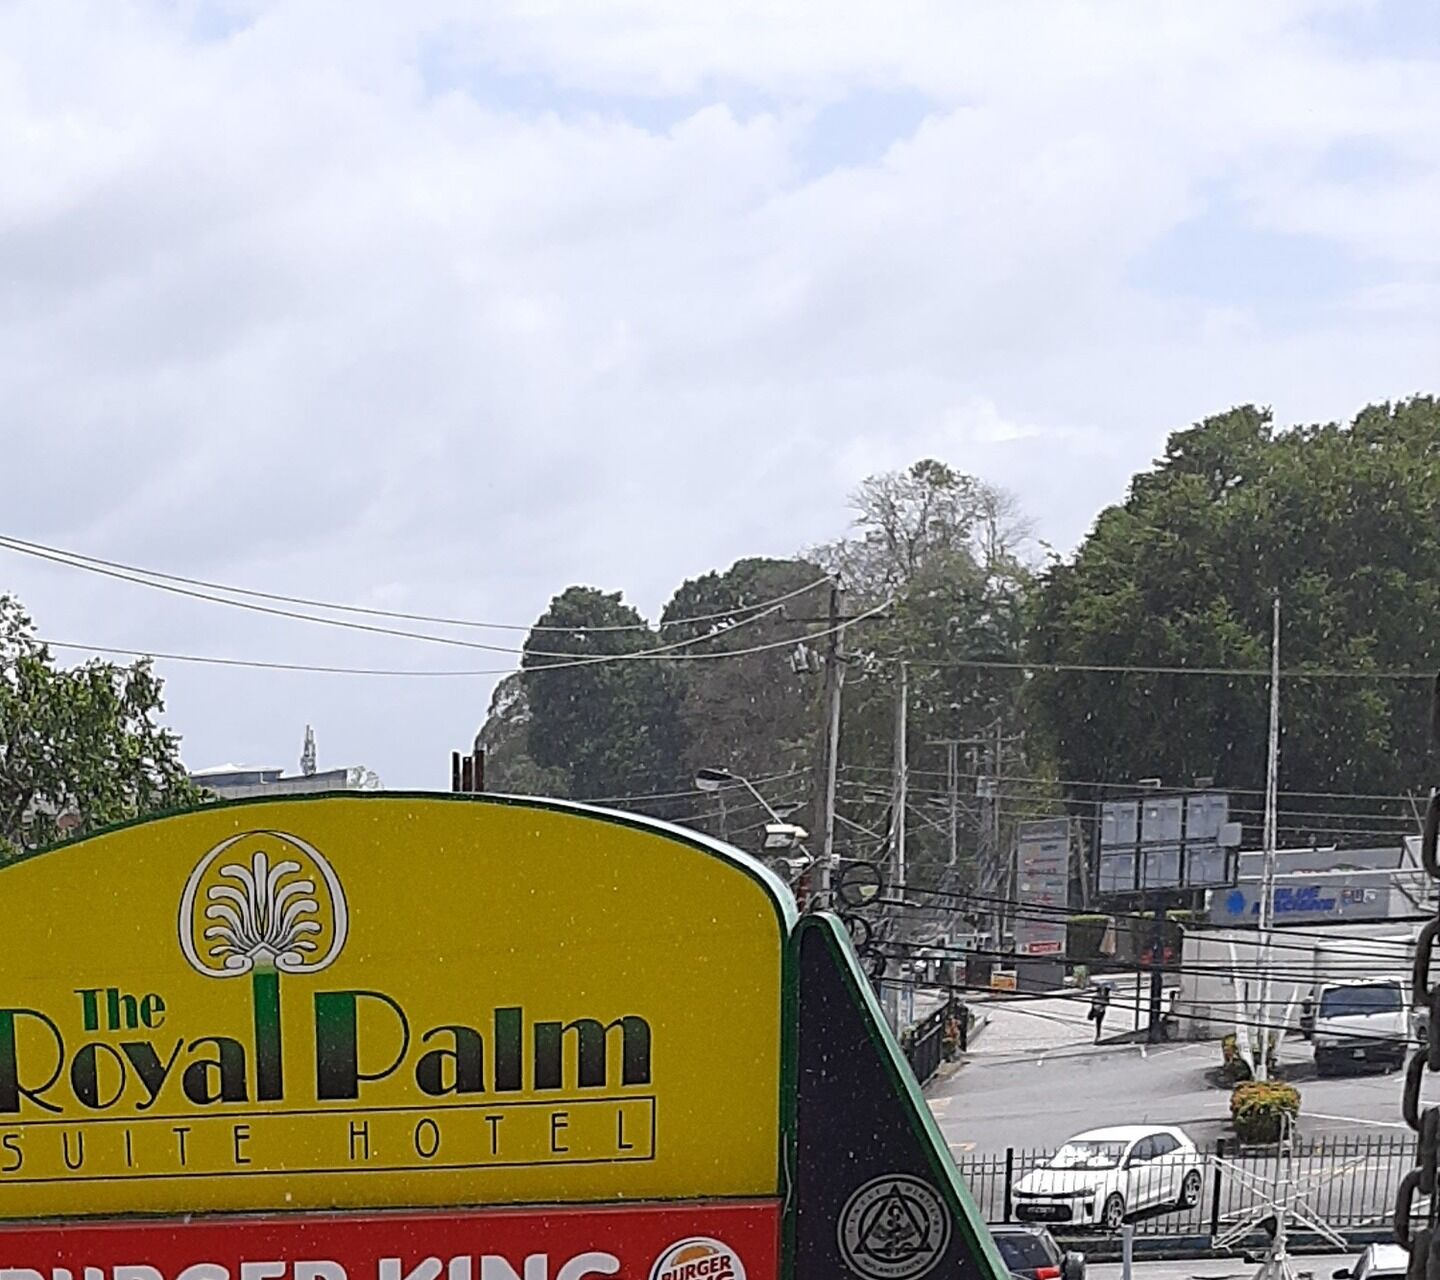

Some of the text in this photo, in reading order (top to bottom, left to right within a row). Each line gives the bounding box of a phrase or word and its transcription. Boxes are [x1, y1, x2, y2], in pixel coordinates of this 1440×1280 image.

[75, 988, 166, 1031] The
[315, 990, 654, 1101] Palm
[0, 1110, 636, 1173] SUITE HOTEL
